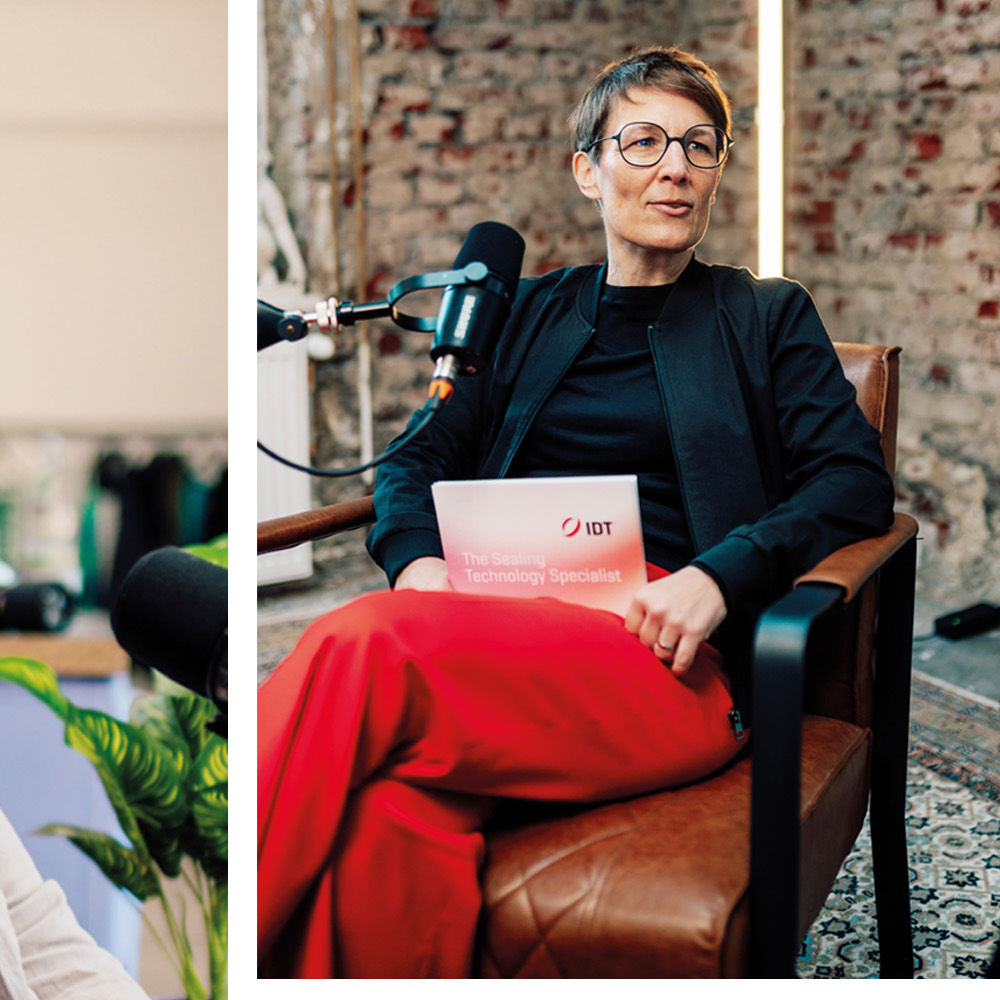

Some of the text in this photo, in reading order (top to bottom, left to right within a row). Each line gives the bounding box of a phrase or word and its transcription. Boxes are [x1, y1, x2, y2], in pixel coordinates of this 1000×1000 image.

[586, 521, 613, 536] IDT
[462, 551, 546, 569] The Sealing
[464, 568, 623, 586] Technology Specialist
